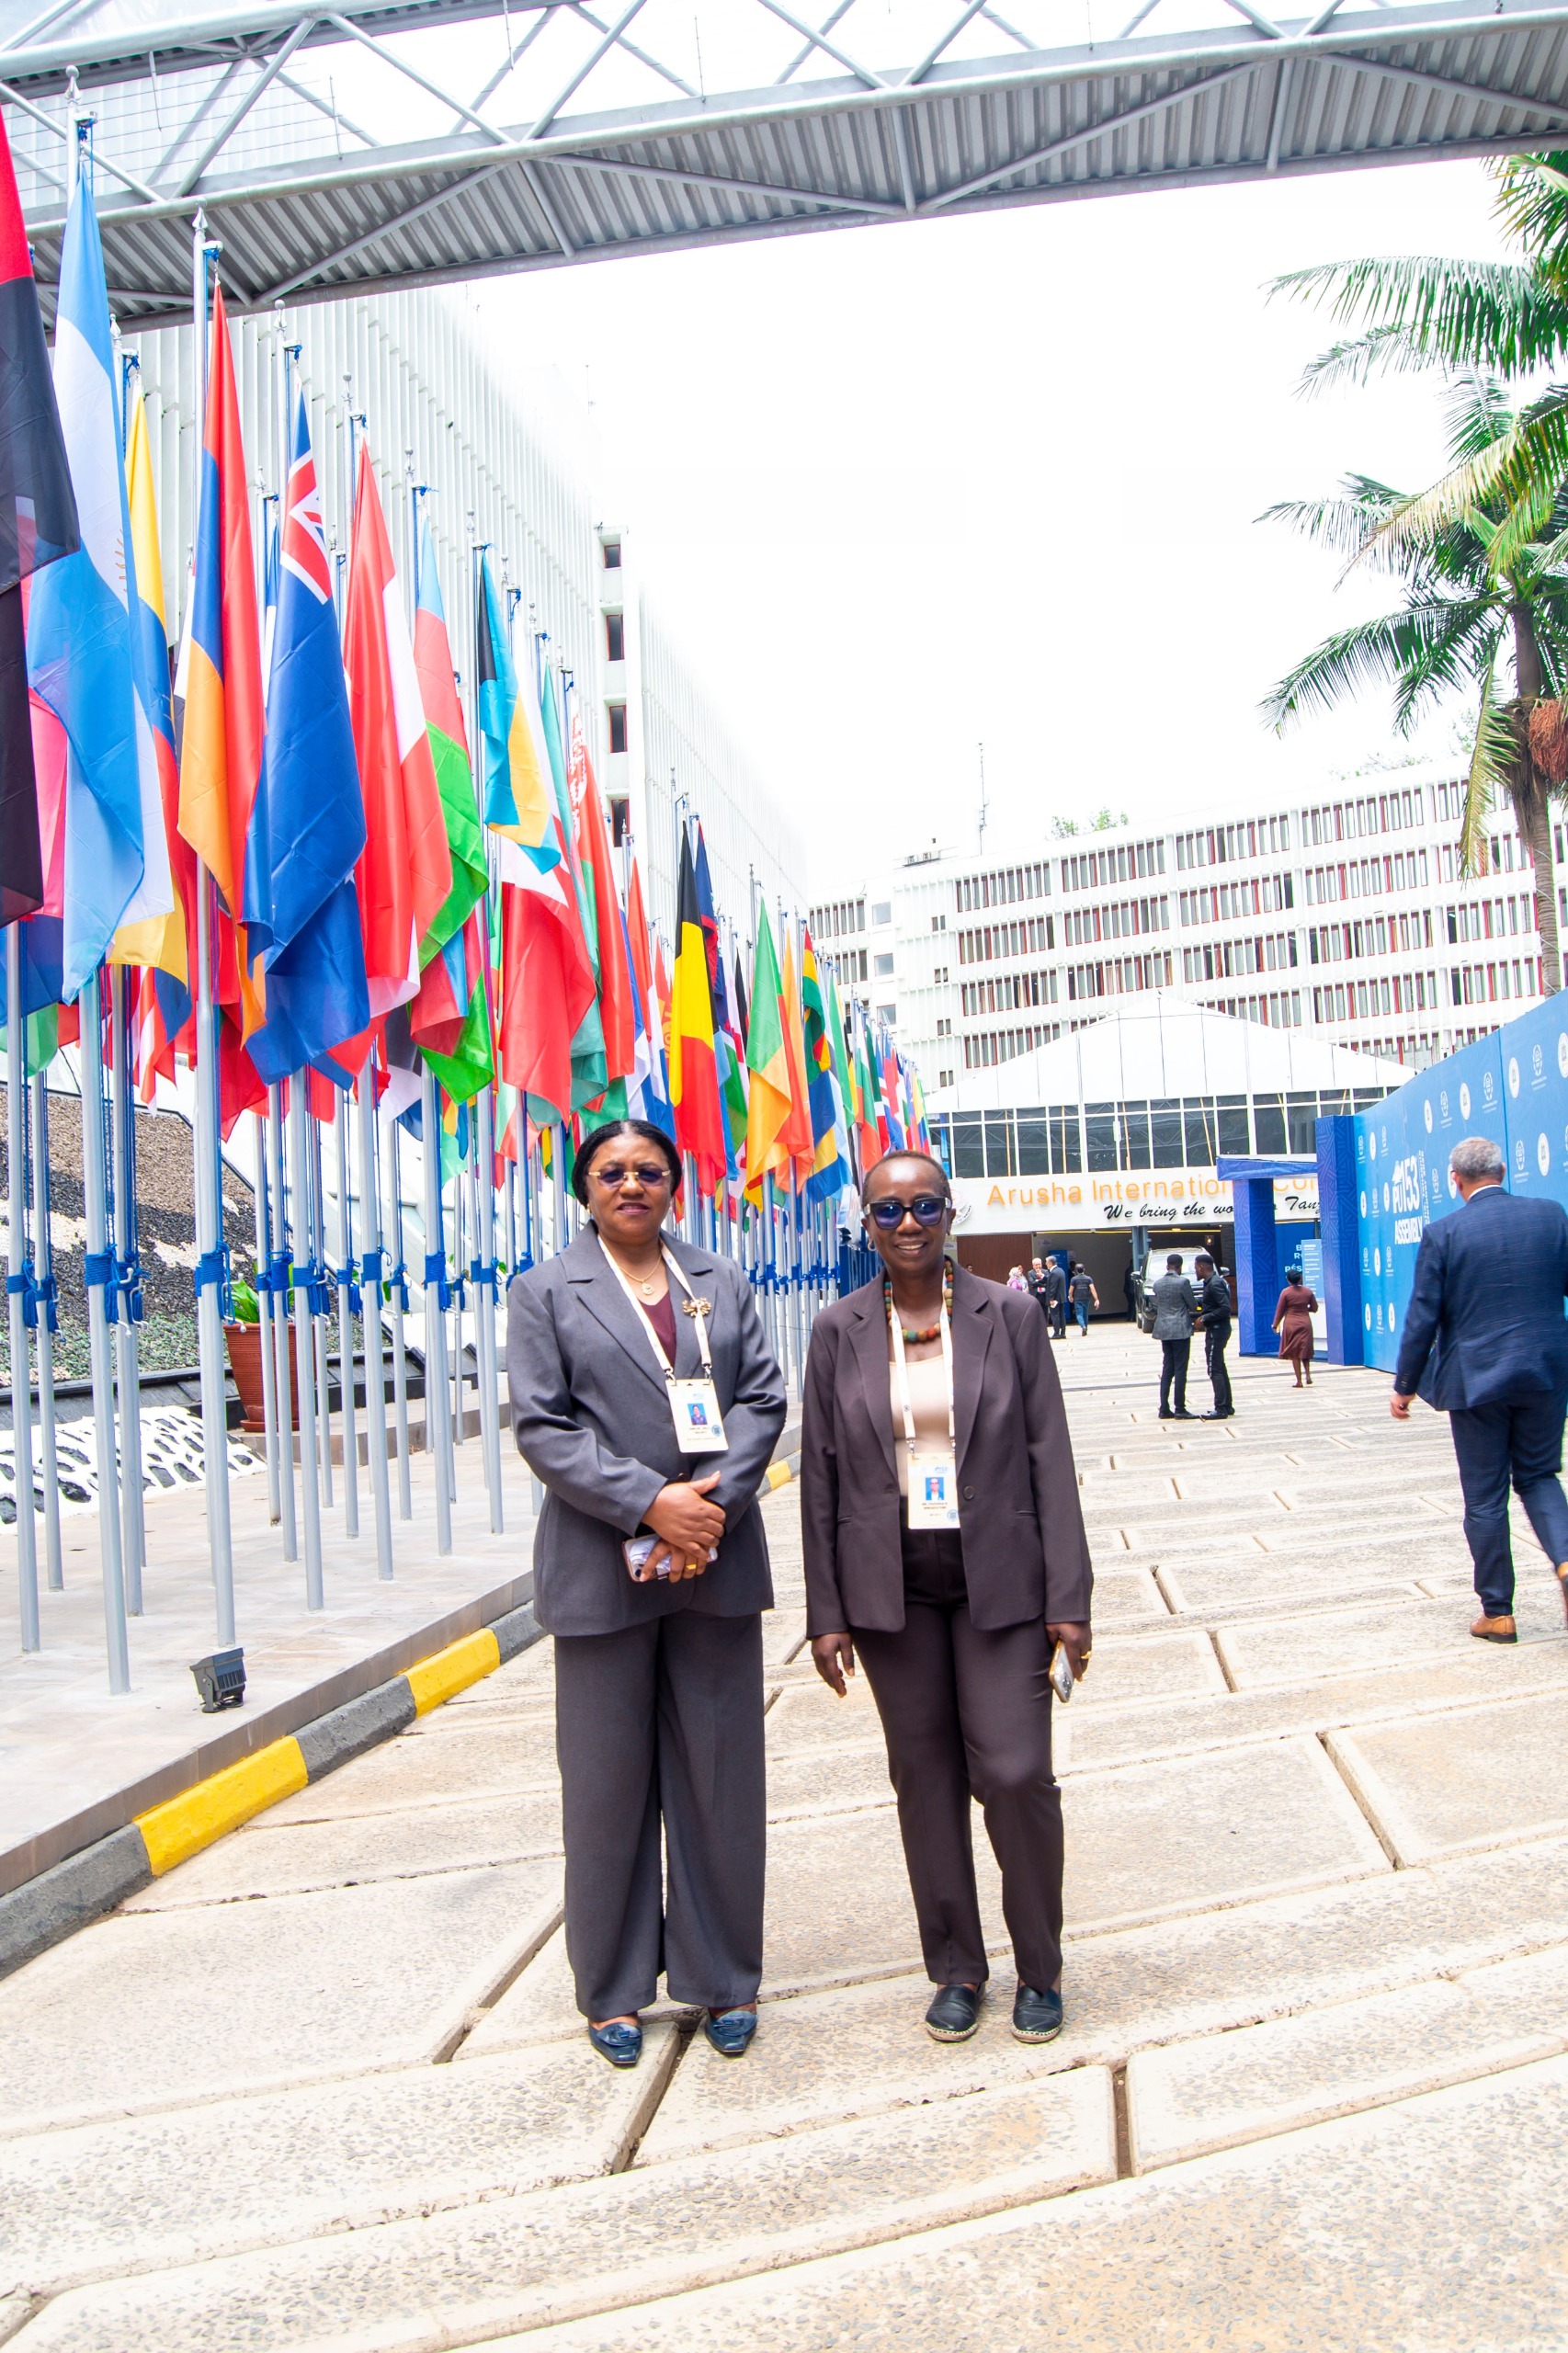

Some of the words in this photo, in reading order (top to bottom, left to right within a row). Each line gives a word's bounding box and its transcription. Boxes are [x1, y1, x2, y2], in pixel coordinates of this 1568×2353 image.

[987, 1181, 1083, 1206] Arusha
[1104, 1204, 1133, 1221] We
[1140, 1203, 1178, 1222] bring
[1184, 1201, 1206, 1216] the
[1394, 1215, 1423, 1245] ASSEMBLY
